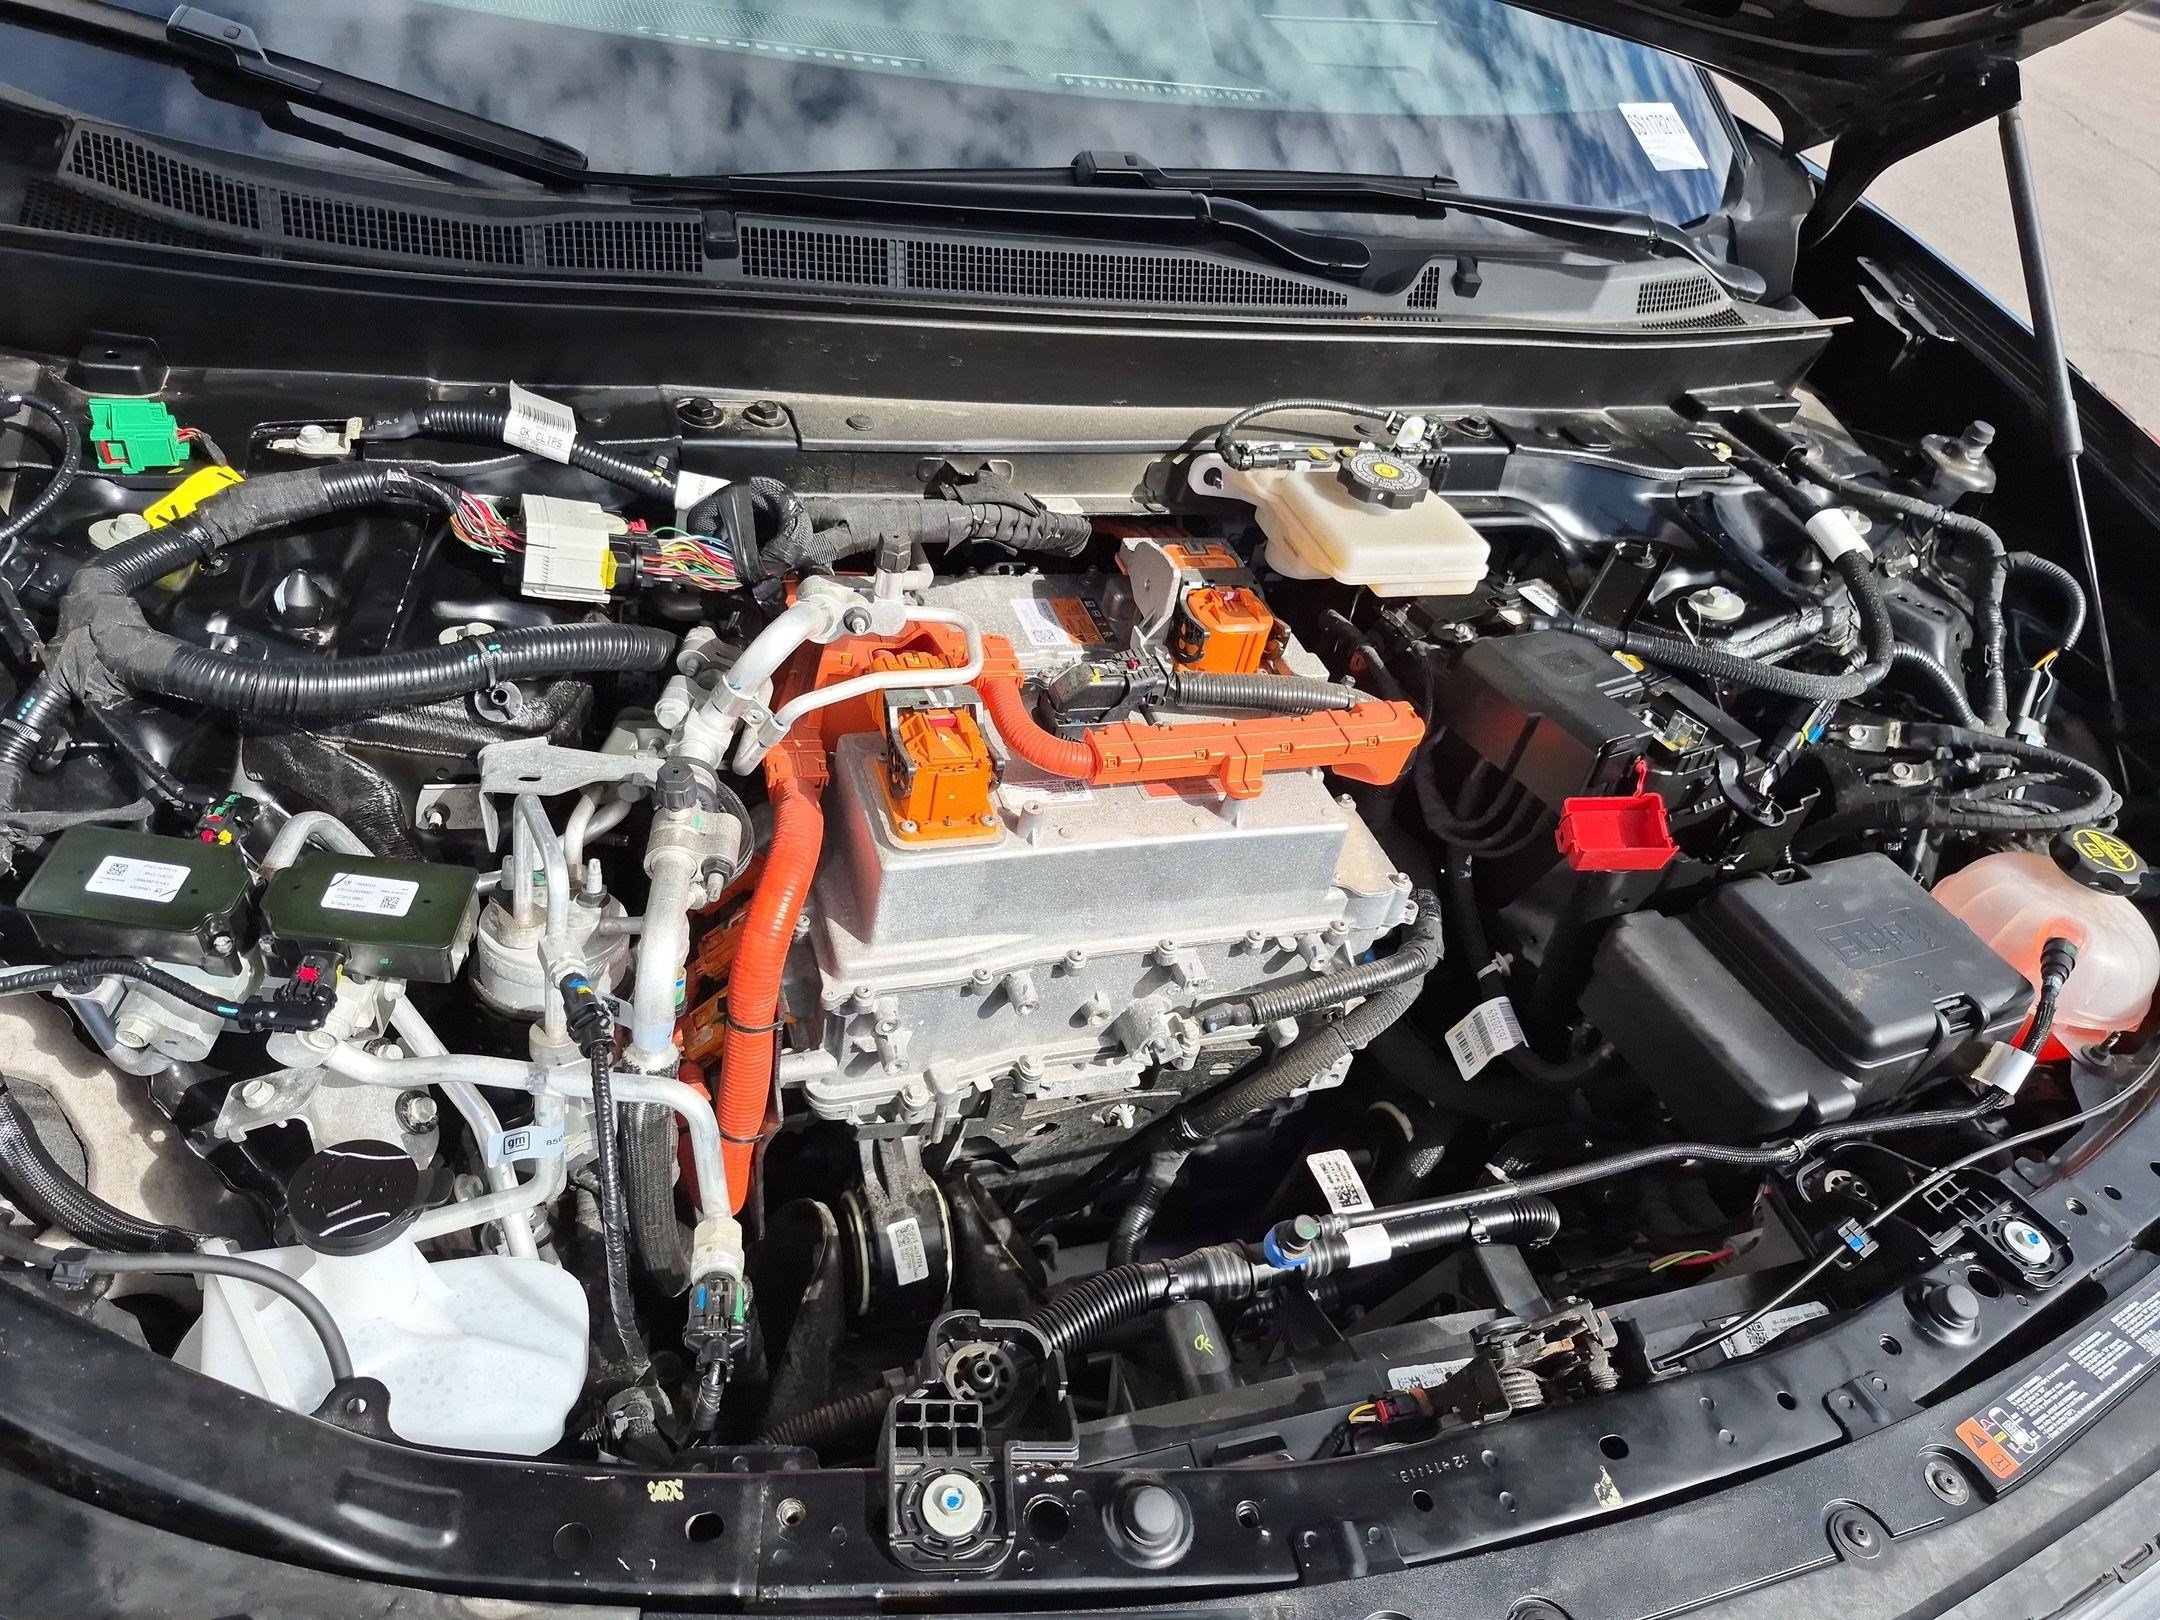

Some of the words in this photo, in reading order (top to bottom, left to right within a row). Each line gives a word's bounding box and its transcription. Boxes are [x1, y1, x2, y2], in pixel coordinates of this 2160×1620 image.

[519, 427, 531, 439] OK
[536, 430, 564, 449] CLIPS
[1487, 1008, 1508, 1043] 26520369
[508, 1136, 525, 1150] gm
